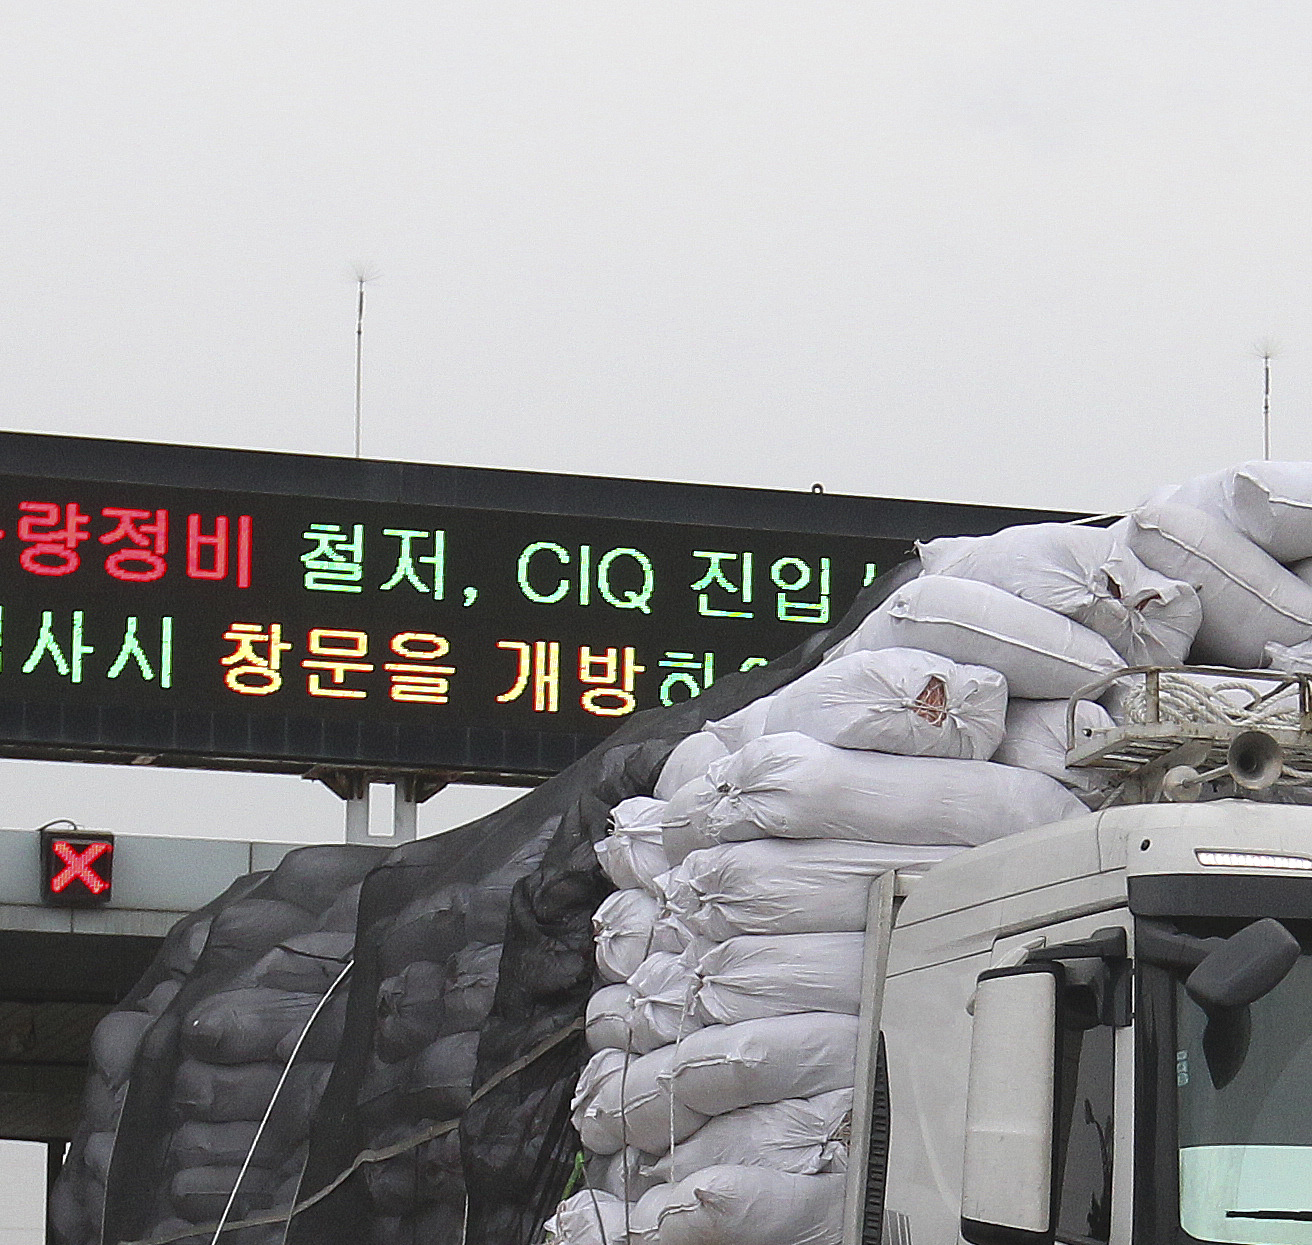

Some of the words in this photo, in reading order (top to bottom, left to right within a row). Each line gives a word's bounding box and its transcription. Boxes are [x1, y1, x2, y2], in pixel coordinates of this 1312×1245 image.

[301, 524, 477, 606] 철저,
[518, 542, 654, 614] CIQ
[691, 551, 830, 623] 진입
[220, 623, 455, 704] 창문을
